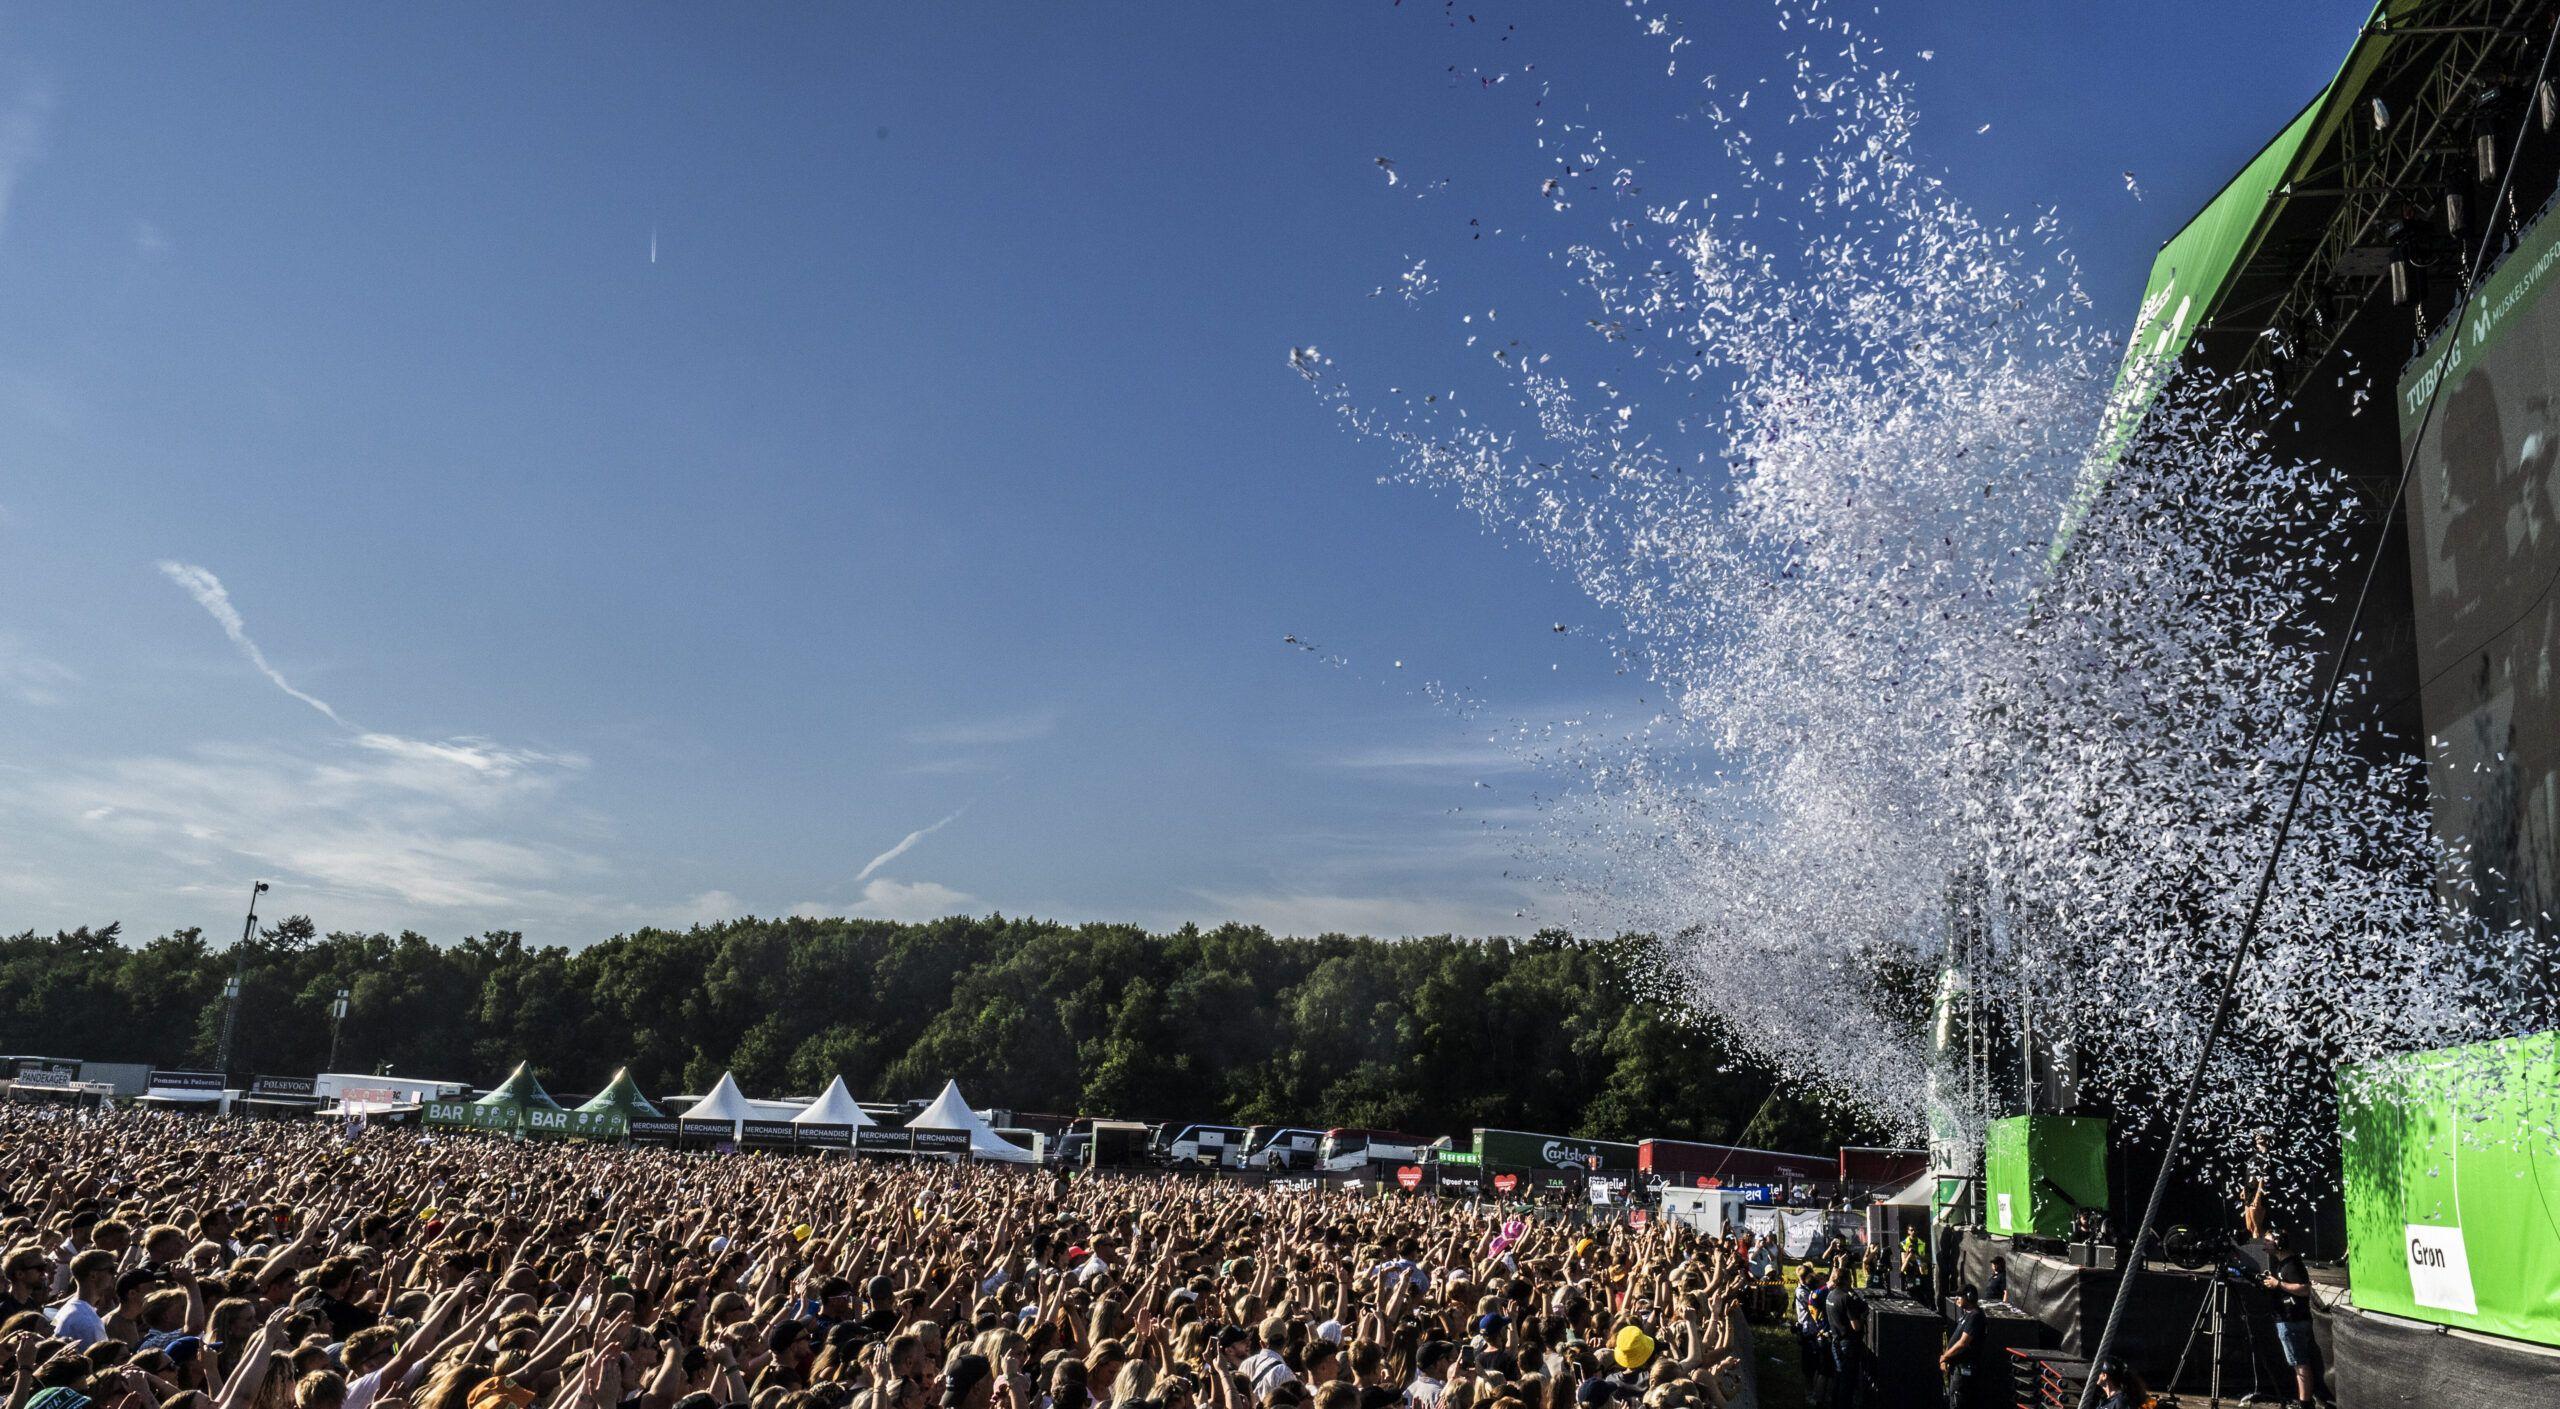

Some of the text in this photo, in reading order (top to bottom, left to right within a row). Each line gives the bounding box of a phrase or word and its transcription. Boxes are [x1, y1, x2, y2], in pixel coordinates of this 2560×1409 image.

[429, 1104, 464, 1120] BAR
[531, 1112, 568, 1128] BAR
[632, 1122, 678, 1131] MERCHANDISE
[684, 1124, 732, 1133] MERCHANDISE
[744, 1126, 793, 1135] MERCHANDISE
[799, 1128, 849, 1138] MERCHANDISE
[859, 1131, 910, 1141] MERCHANDISE
[915, 1133, 967, 1144] MERCHANDISE
[1403, 1179, 1416, 1187] TAK
